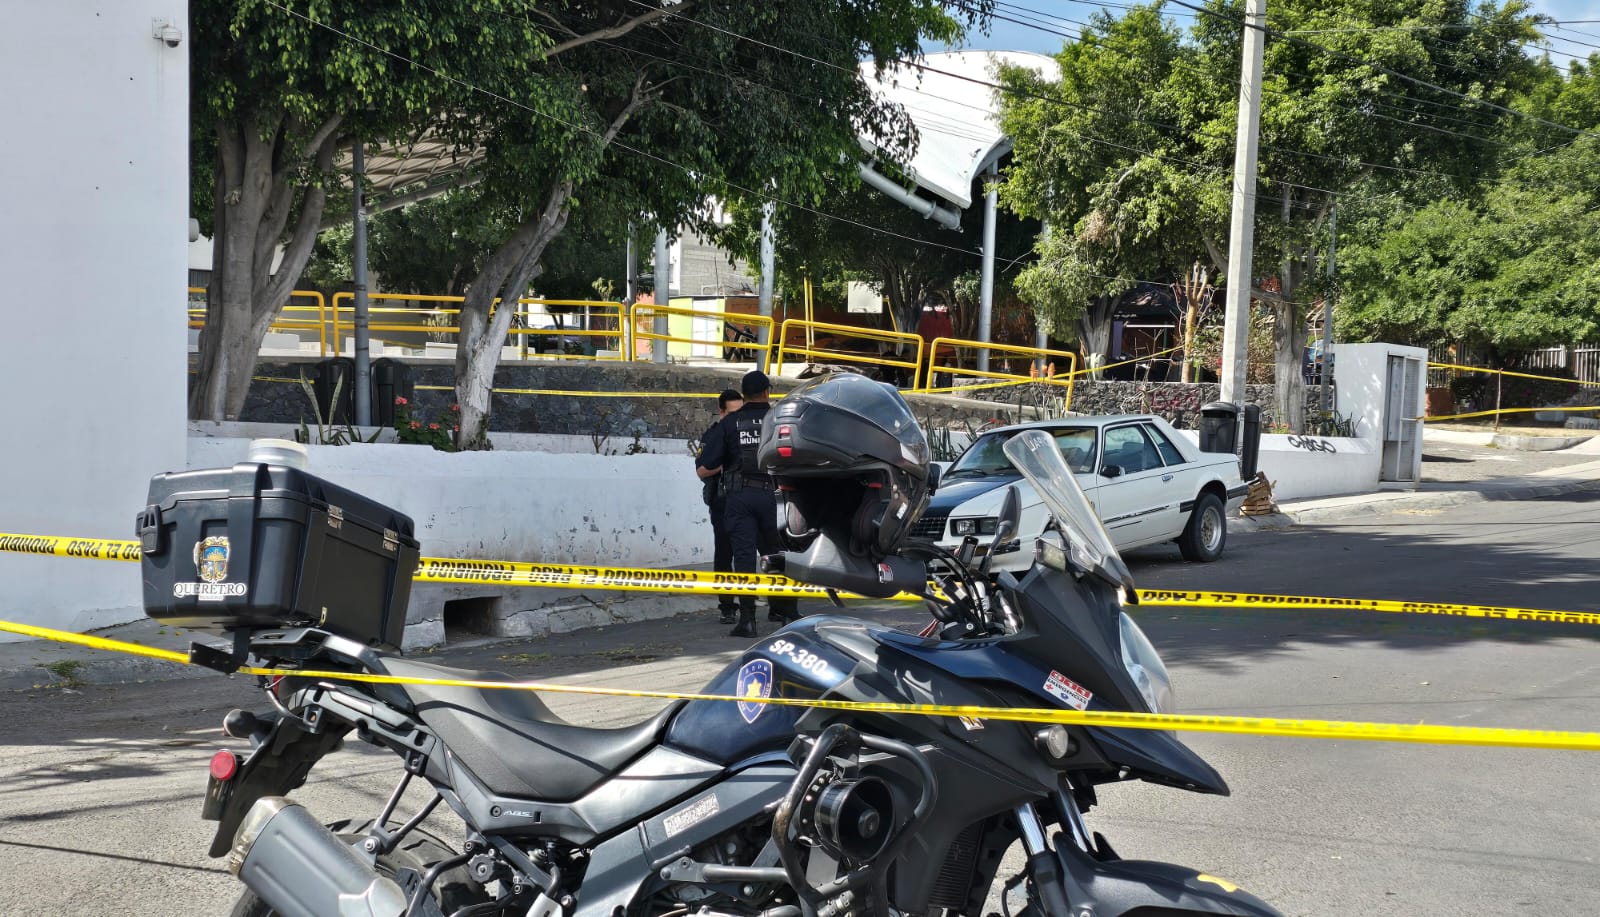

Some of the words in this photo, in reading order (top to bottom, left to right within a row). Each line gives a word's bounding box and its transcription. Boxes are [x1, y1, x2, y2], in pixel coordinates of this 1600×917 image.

[740, 437, 761, 445] MUNI
[0, 536, 57, 554] PROHIBID
[66, 537, 102, 557] PASO
[106, 544, 120, 559] EL
[427, 560, 516, 582] PROHIBIDO
[528, 564, 573, 584] PASO
[579, 567, 599, 585] EL
[602, 568, 698, 589] PROHIBIDO
[713, 574, 760, 592] PASO
[769, 639, 829, 676] SP-380
